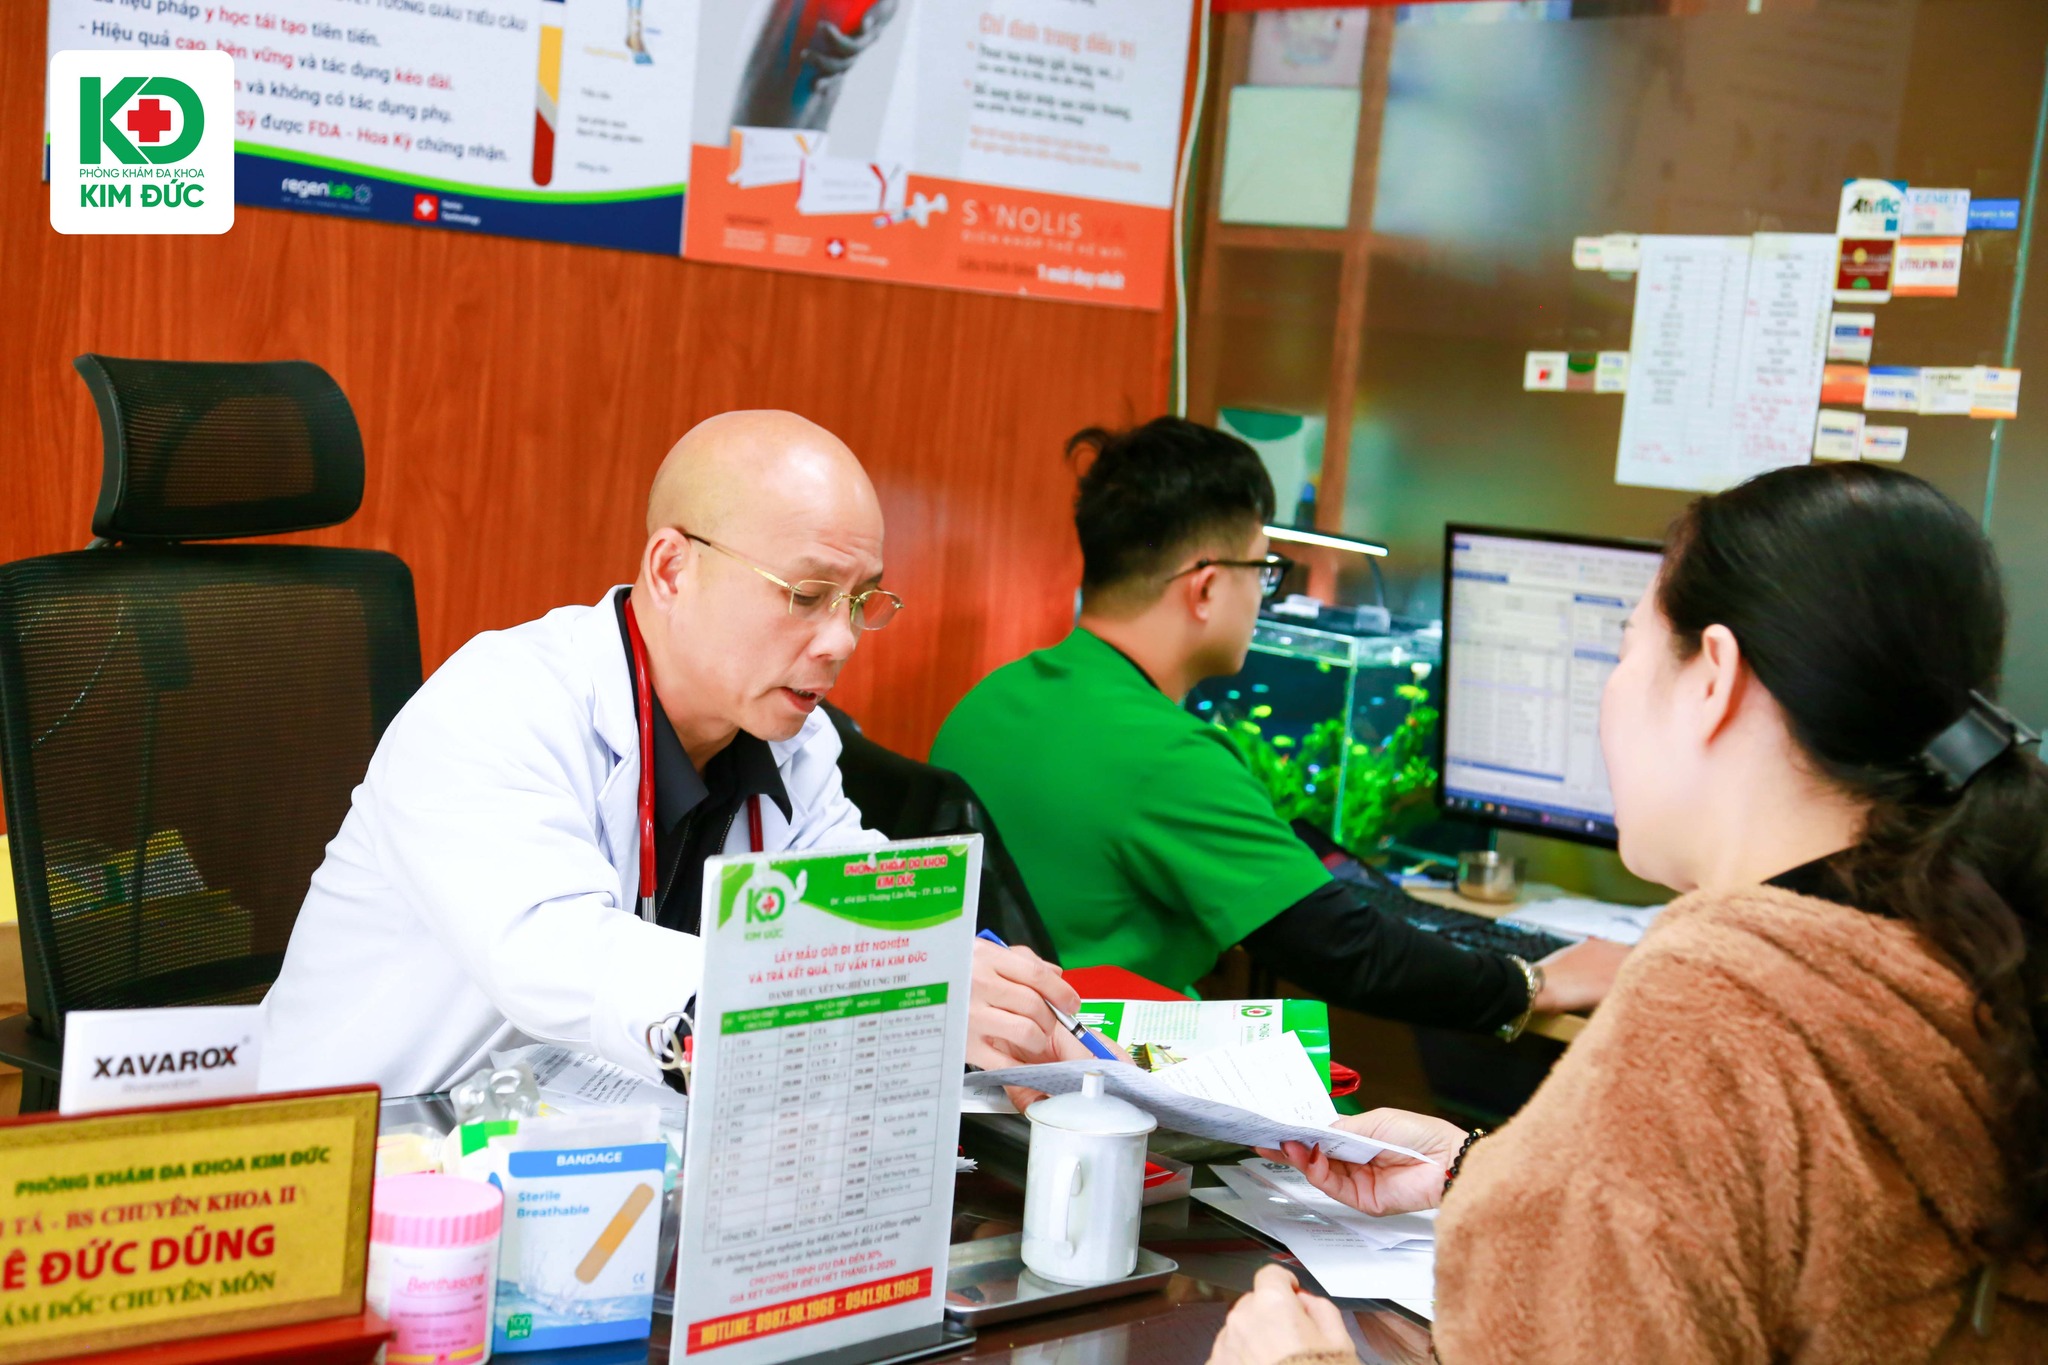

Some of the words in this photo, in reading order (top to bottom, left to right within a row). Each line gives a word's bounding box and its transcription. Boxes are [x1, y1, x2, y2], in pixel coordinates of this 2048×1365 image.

[205, 8, 214, 22] y
[219, 6, 250, 25] học
[255, 13, 277, 30] tái
[281, 18, 308, 34] tạo
[312, 23, 342, 40] tiên
[91, 20, 132, 41] Hiệu
[138, 30, 171, 47] quả
[252, 45, 294, 70] vững
[299, 53, 317, 69] và
[321, 56, 347, 74] tác
[351, 62, 391, 84] dụng
[395, 66, 423, 86] kéo
[247, 80, 265, 95] và
[270, 81, 321, 106] không
[325, 91, 345, 107] có
[350, 93, 374, 111] tác
[378, 97, 417, 120] dụng
[261, 113, 304, 134] được
[308, 119, 341, 138] FDA
[357, 128, 389, 145] Hoa
[416, 136, 464, 158] chứng
[841, 944, 851, 955] ĐI
[853, 940, 870, 954] XÉT
[872, 936, 910, 952] NGHIỆM
[749, 972, 763, 984] VÀ
[766, 968, 785, 982] TRẢ
[787, 965, 804, 979] KẾT
[848, 958, 868, 972] VẤN
[888, 954, 905, 966] KIM
[908, 951, 928, 964] ĐỨC
[93, 1045, 240, 1080] XAVAROX
[14, 1172, 89, 1197] PHÒNG
[95, 1165, 155, 1187] KHÁM
[159, 1163, 187, 1180] ĐA
[192, 1157, 245, 1177] KHOA
[250, 1153, 287, 1171] KIM
[290, 1146, 331, 1165] ĐỨC
[556, 1152, 623, 1167] BANDAGE
[14, 1210, 43, 1236] TÁ
[66, 1209, 94, 1230] BS
[101, 1193, 200, 1226] CHUYÊN
[206, 1188, 274, 1213] KHOA
[279, 1186, 297, 1203] II
[516, 1205, 590, 1219] Breathable
[2, 1248, 27, 1292] Ê
[39, 1237, 139, 1287] ĐỨC
[150, 1223, 276, 1272] DŨNG
[1, 1303, 40, 1327] ÁM
[48, 1290, 100, 1321] ĐỐC
[109, 1278, 213, 1312] CHUYÊN
[219, 1269, 277, 1296] MÔN
[755, 1296, 836, 1333] 0987.98.1968
[845, 1276, 920, 1312] 0941.98.1968
